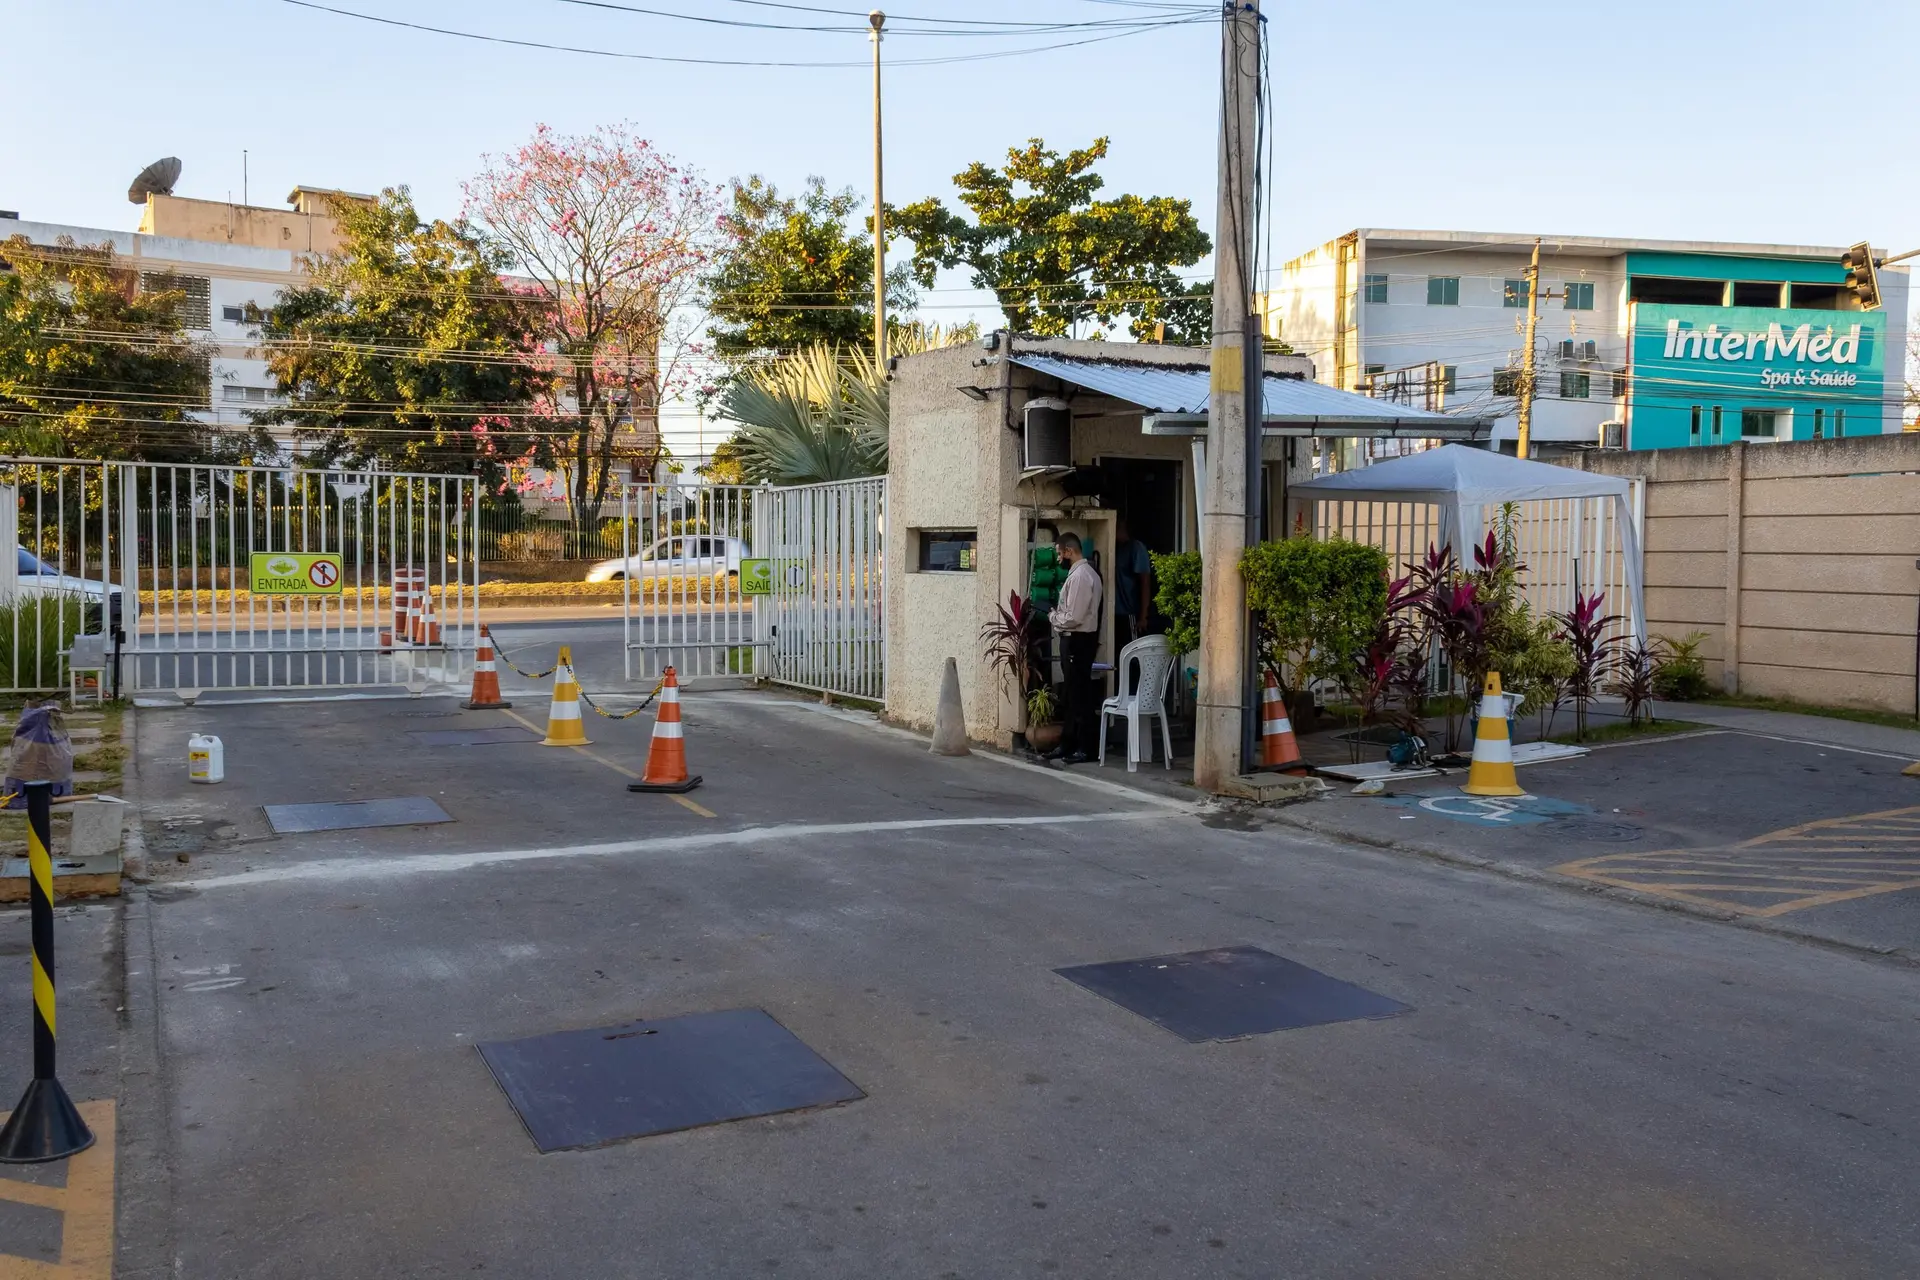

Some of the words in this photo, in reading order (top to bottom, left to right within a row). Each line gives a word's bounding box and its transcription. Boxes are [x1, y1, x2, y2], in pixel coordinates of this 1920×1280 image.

[1663, 319, 1861, 363] InterMed
[1761, 368, 1790, 389] Spa
[1793, 369, 1806, 385] &
[1809, 369, 1857, 387] Saúde
[258, 578, 308, 590] ENTRADA
[746, 578, 781, 591] SAÍD
